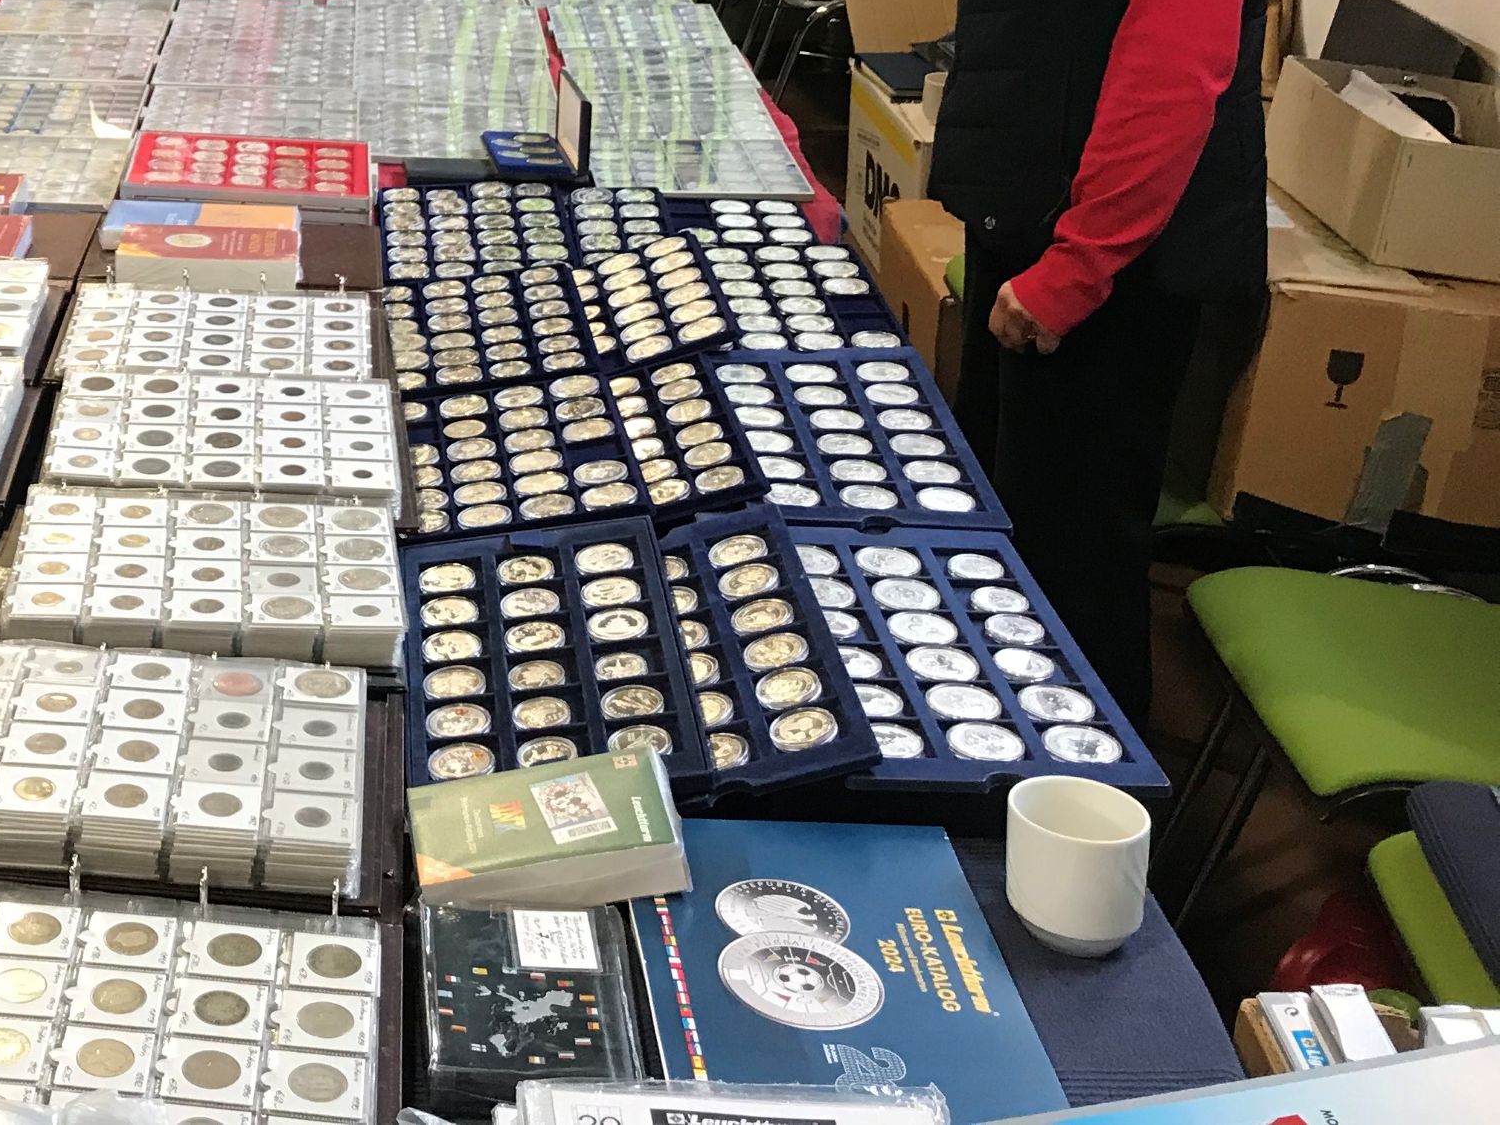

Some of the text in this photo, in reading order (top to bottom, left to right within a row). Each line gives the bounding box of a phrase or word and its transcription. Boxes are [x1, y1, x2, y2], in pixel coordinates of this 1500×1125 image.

[631, 795, 653, 843] Leuchtturm
[877, 938, 906, 973] 2024
[904, 907, 961, 1012] EURO-KATALOG
[940, 923, 992, 1013] Leuchtturm
